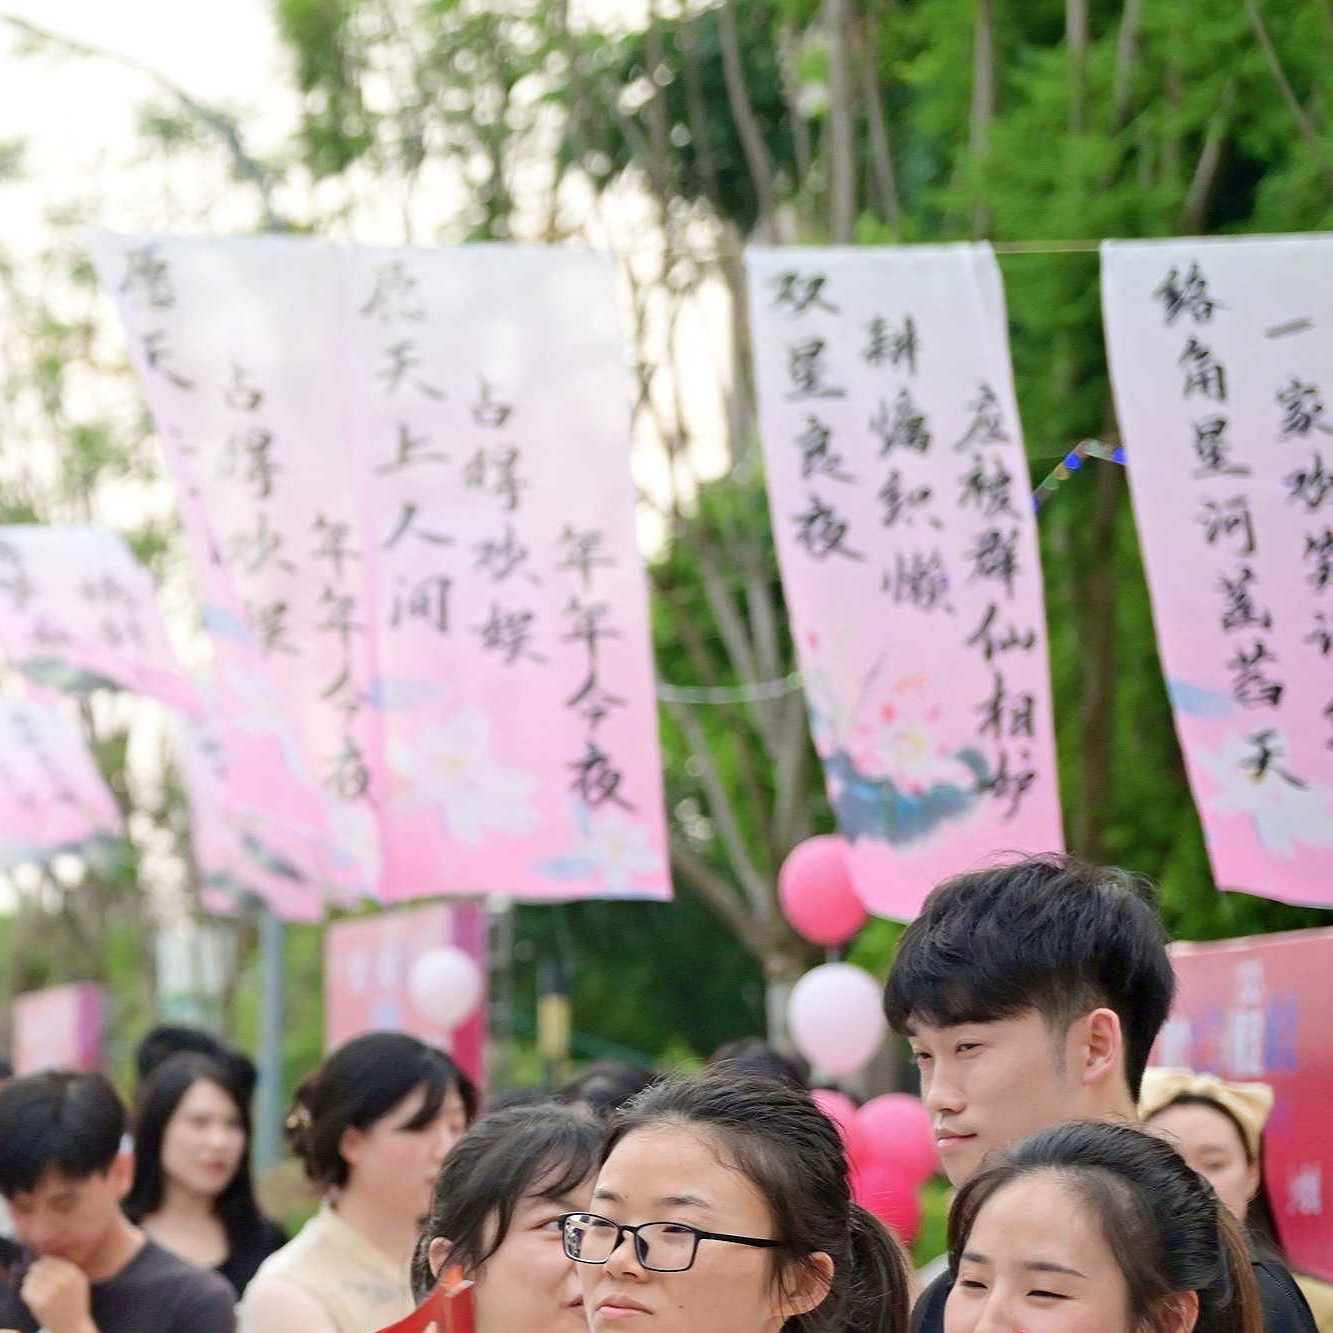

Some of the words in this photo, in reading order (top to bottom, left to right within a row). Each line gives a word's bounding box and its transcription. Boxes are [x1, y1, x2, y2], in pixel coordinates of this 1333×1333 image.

[462, 374, 553, 669] 占得欢娱
[769, 268, 865, 563] 双星良夜
[860, 314, 956, 617] 耕慵织懒
[1152, 258, 1309, 792] 络角星河菡萏天
[553, 522, 637, 814] 年年今夜
[951, 382, 1043, 820] 应被群仙相妒
